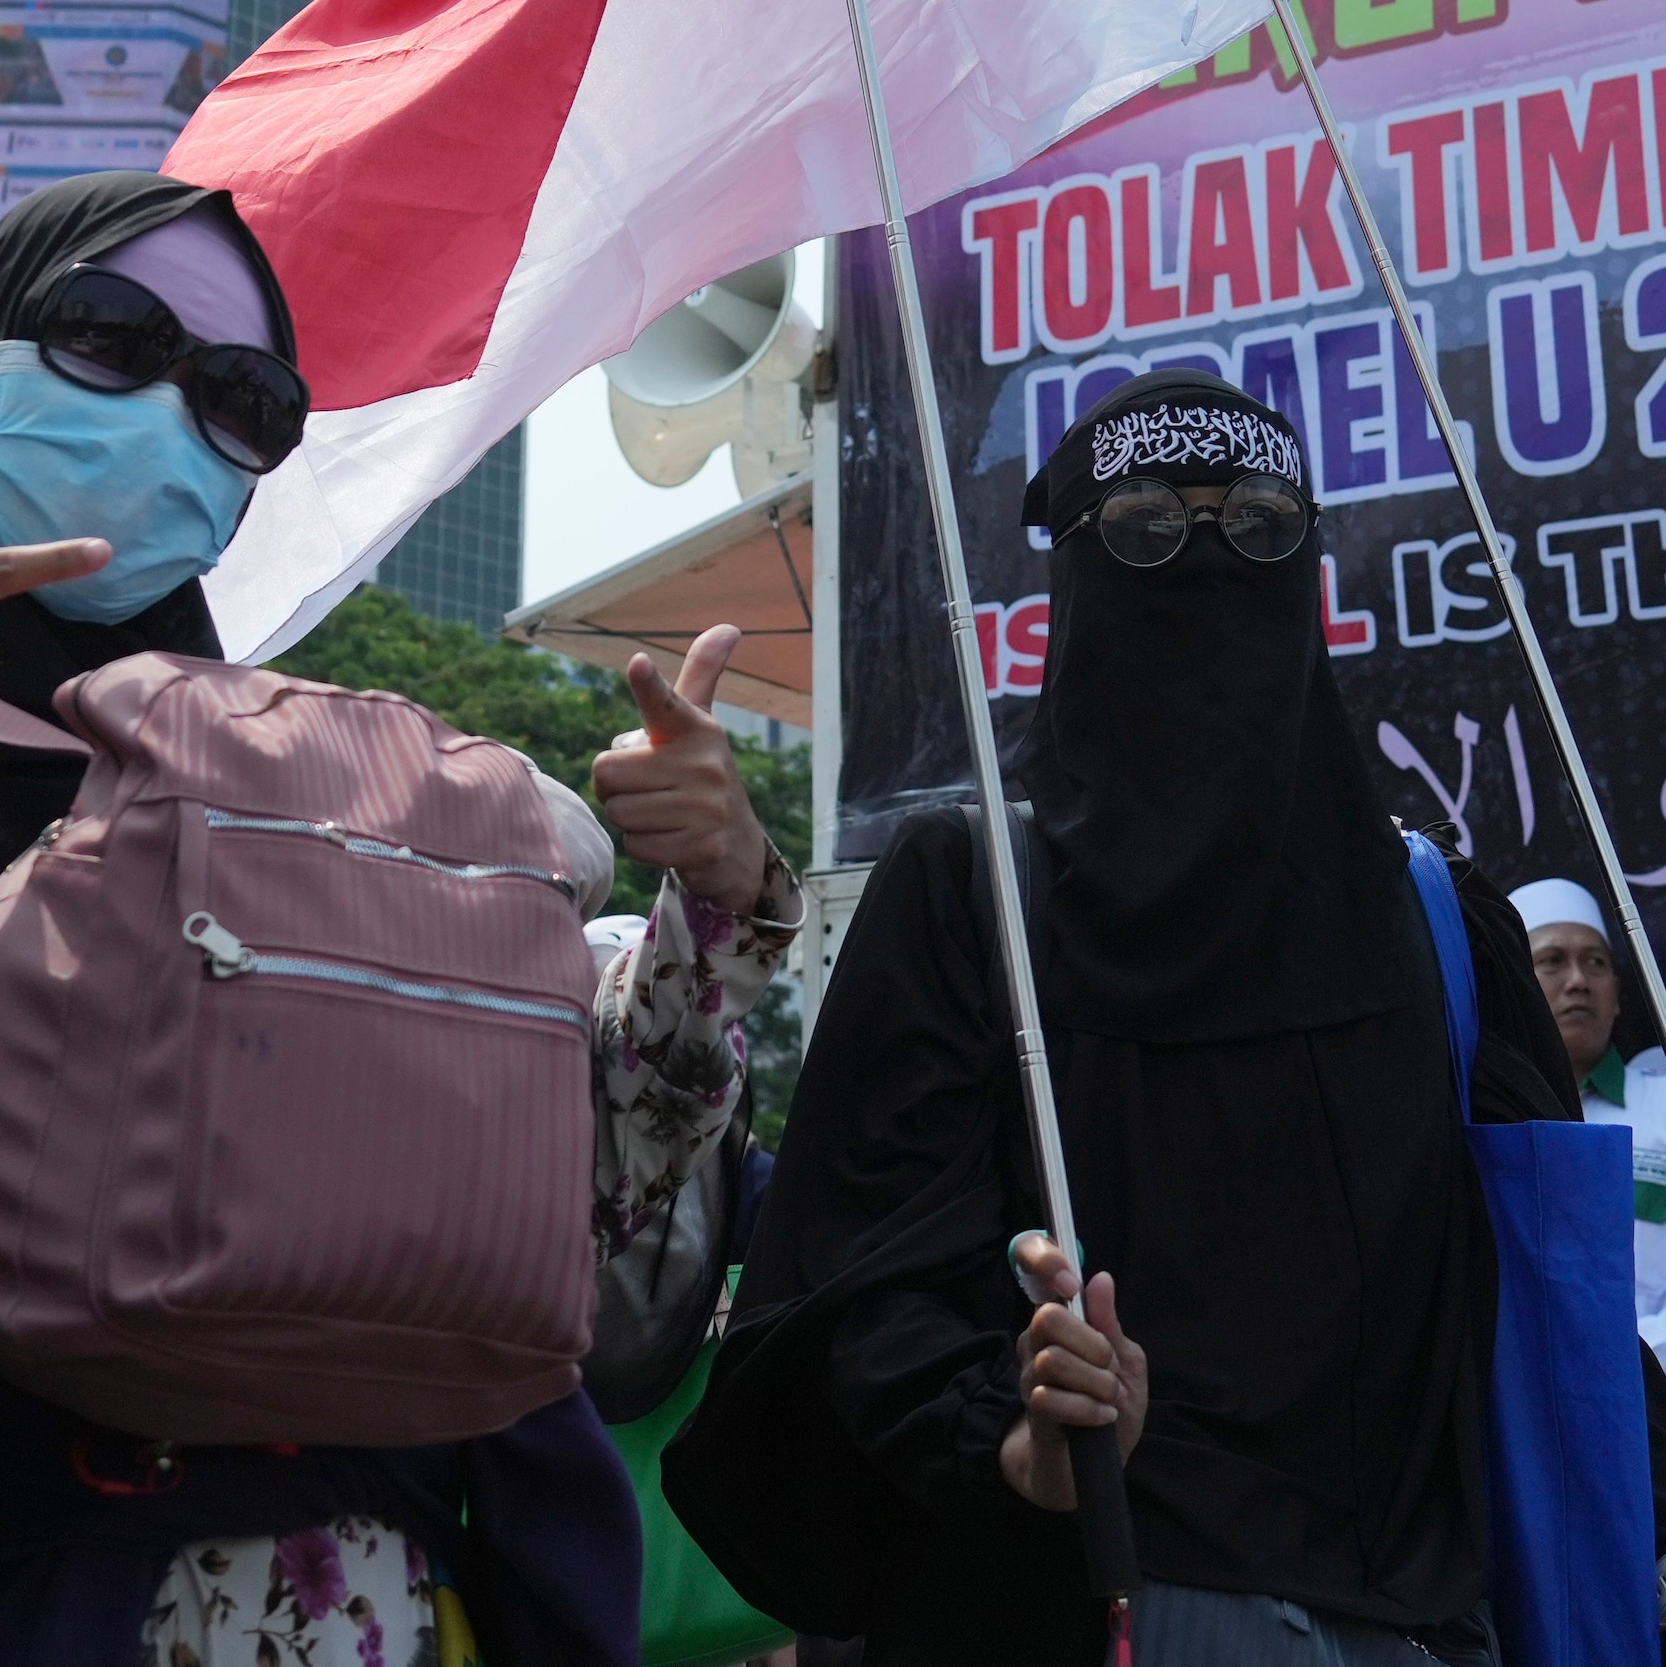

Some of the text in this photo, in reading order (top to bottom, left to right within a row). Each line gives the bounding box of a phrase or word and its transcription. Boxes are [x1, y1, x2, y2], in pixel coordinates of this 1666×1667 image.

[968, 128, 1357, 360] TOLAK
[1495, 279, 1601, 468] U
[1396, 534, 1523, 646] IS
